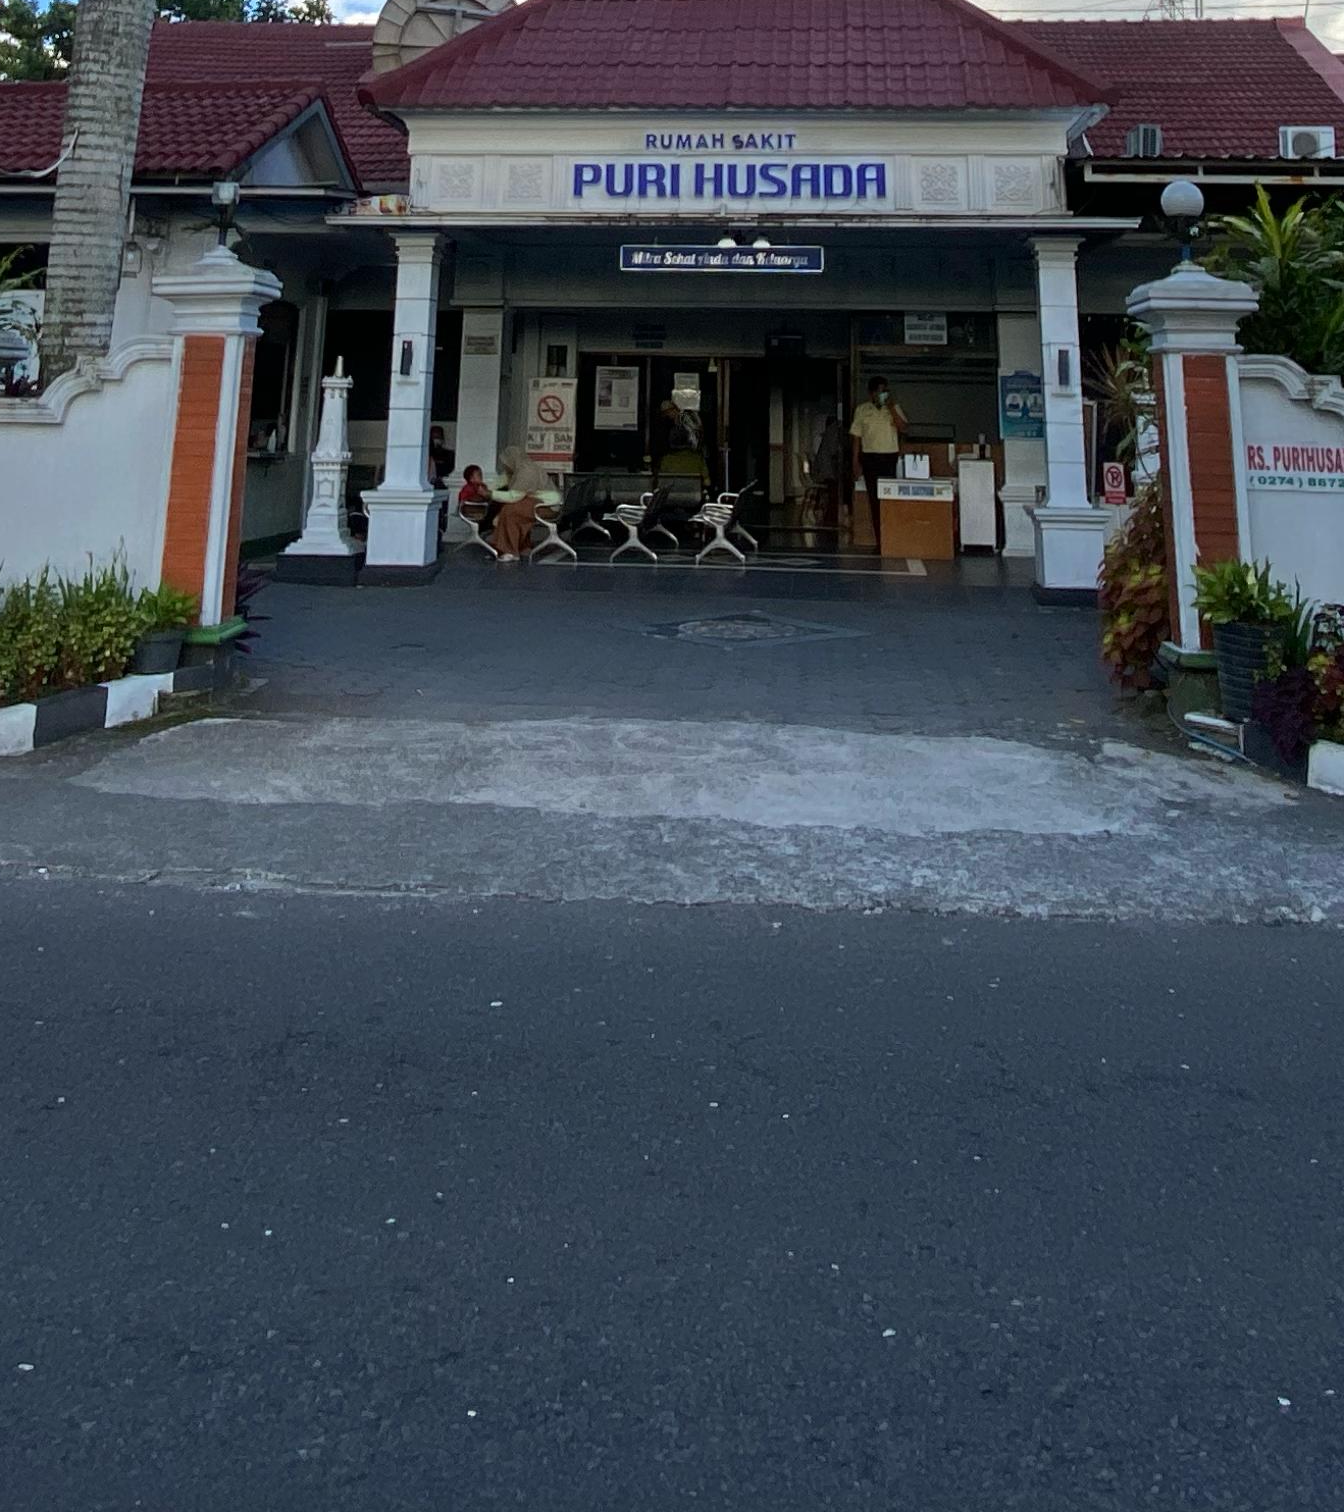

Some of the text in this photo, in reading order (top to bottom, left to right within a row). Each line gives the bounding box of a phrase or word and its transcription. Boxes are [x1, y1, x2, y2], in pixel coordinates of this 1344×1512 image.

[646, 133, 796, 150] RUMAH SAKIT
[573, 163, 886, 200] PURI HUSADA
[1247, 445, 1270, 471] RS.
